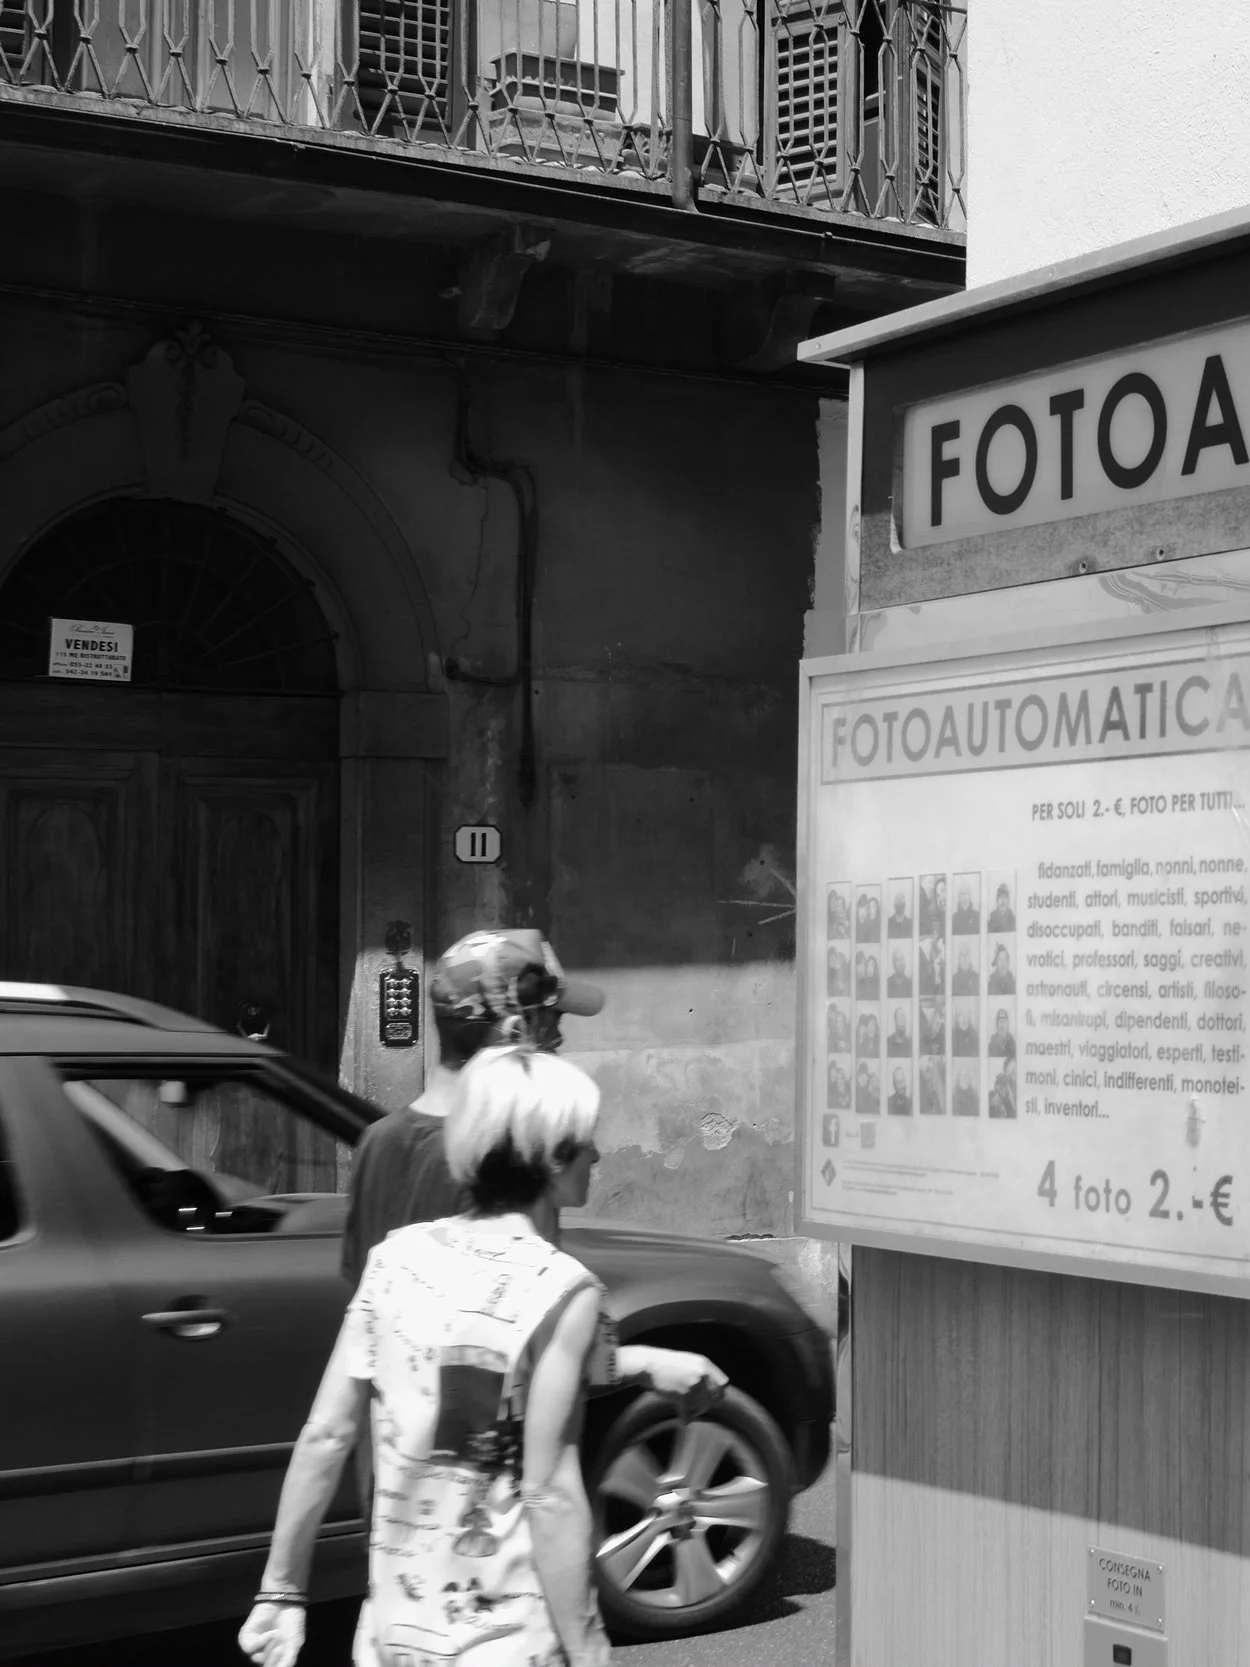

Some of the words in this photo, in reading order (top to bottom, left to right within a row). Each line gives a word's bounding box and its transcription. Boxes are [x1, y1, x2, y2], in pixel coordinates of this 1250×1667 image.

[65, 639, 118, 652] VENDESI
[1031, 801, 1054, 821] PER
[1056, 800, 1085, 821] SOLI
[1130, 795, 1167, 816] FOTO
[1171, 793, 1195, 812] PER
[470, 832, 487, 857] 11
[1037, 859, 1096, 880] fidanzati,
[1096, 863, 1153, 880] famiglia,
[1155, 859, 1198, 877] nonni,
[1199, 855, 1248, 874] nonne,
[1026, 891, 1080, 909] studenti,
[1084, 889, 1122, 909] attori,
[1127, 887, 1188, 908] musicisti,
[1194, 885, 1248, 908] sportivi,
[1027, 919, 1104, 942] disoccupati,
[1112, 919, 1162, 939] banditi,
[1170, 918, 1215, 938] falsari,
[1223, 921, 1247, 936] ne-
[1026, 949, 1068, 969] vrotici,
[1072, 950, 1138, 971] professori,
[1143, 950, 1185, 972] saggi,
[1190, 949, 1247, 969] creativi,
[1025, 980, 1091, 999] astronauti,
[1096, 981, 1152, 1000] circensi,
[1158, 981, 1198, 1000] artisti,
[1204, 980, 1247, 999] filoso-
[1040, 1010, 1110, 1031] misantropi,
[1114, 1011, 1191, 1032] dipendenti,
[1197, 1012, 1246, 1033] dottori,
[1025, 1039, 1074, 1058] maestri,
[1078, 1041, 1152, 1064] viaggiatori,
[1156, 1042, 1207, 1064] esperti,
[1211, 1043, 1245, 1064] testi-
[1025, 1069, 1059, 1087] moni,
[1063, 1070, 1101, 1089] cinici,
[1104, 1071, 1177, 1093] indifferenti,
[1181, 1076, 1245, 1095] monotei-
[1025, 1098, 1041, 1116] sti,
[1044, 1098, 1109, 1119] inventori...
[1037, 1160, 1058, 1207] 4
[1073, 1175, 1132, 1215] foto
[1099, 1558, 1151, 1581] CONSEGNA
[1107, 1578, 1131, 1594] FOTO
[1133, 1585, 1142, 1596] IN
